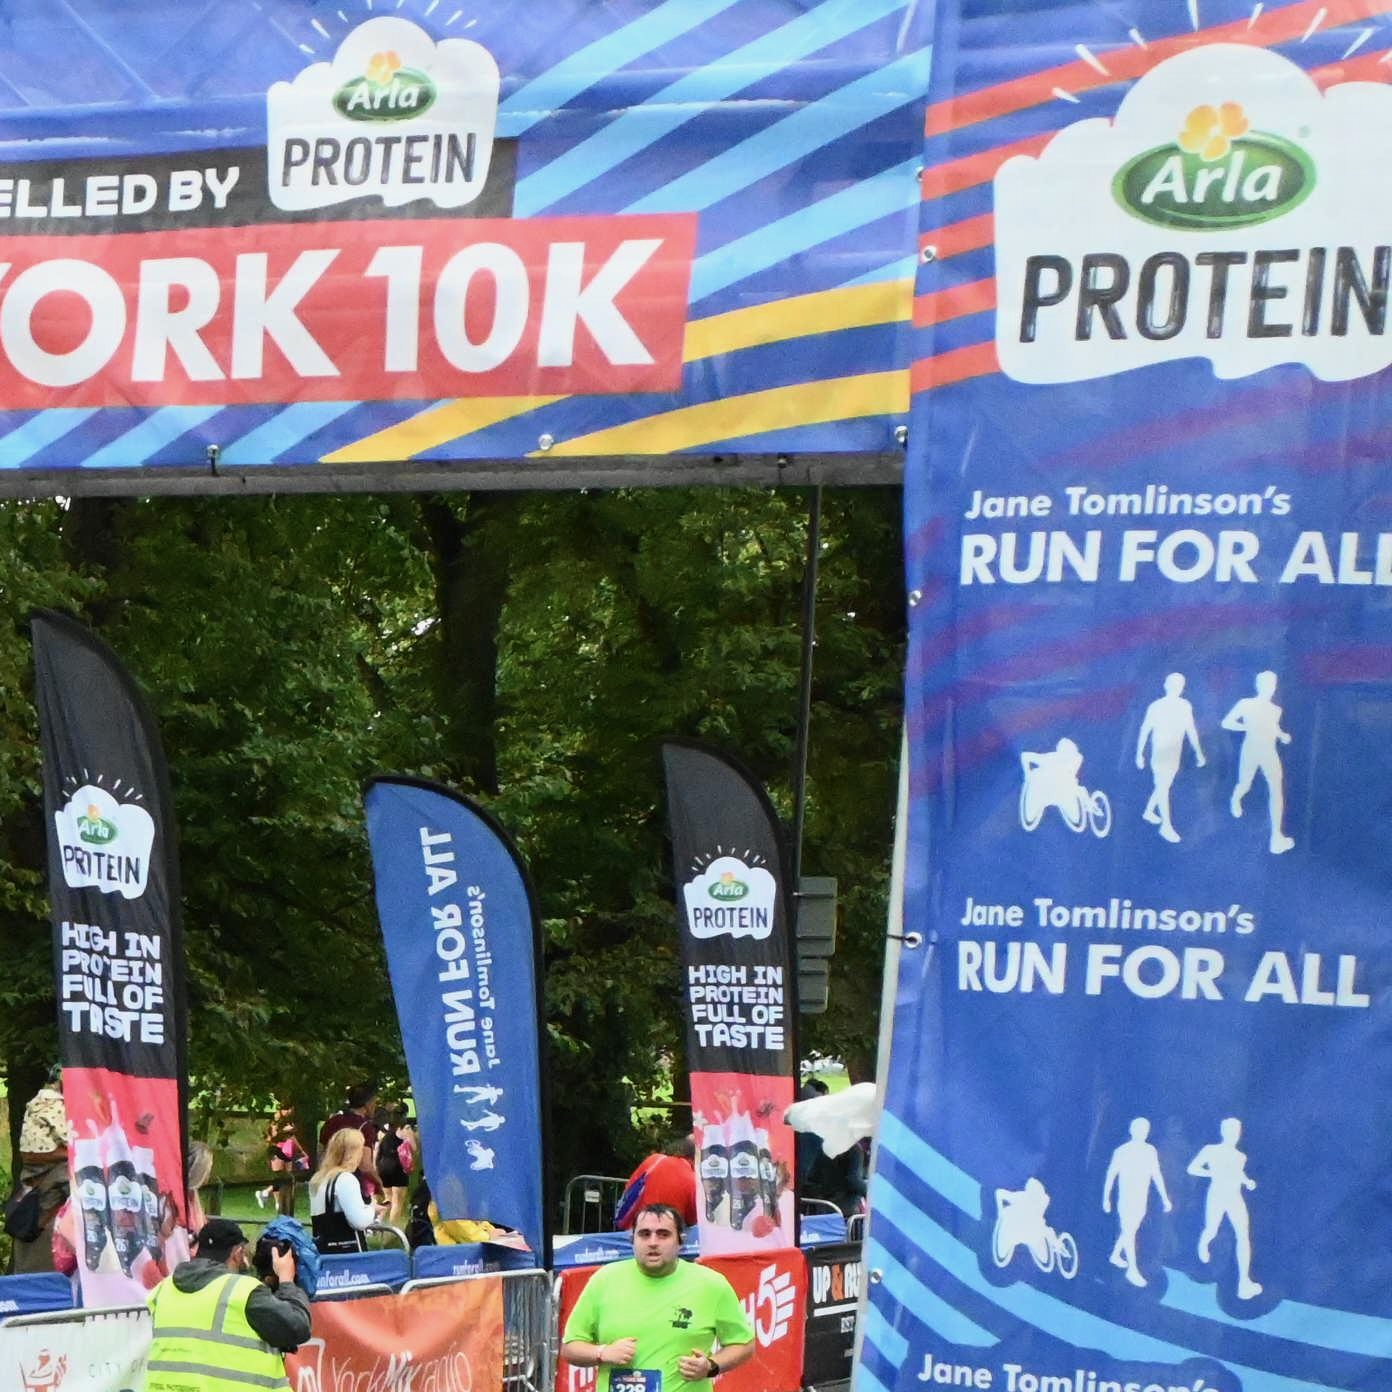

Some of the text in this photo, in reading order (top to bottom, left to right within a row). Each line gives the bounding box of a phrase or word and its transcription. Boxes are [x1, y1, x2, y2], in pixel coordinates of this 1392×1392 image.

[346, 78, 421, 111] Arla
[280, 132, 476, 188] PROTEIN
[1140, 152, 1283, 204] Arla
[168, 166, 241, 213] BY
[362, 239, 665, 374] 10K
[1018, 245, 1391, 343] PROTEIN
[964, 485, 1291, 518] Jane Tomlinson's
[959, 530, 1102, 586] RUN
[1119, 528, 1259, 583] FOR
[79, 820, 109, 837] Arla
[713, 884, 743, 897] Arla
[693, 906, 767, 929] PROTEIN
[961, 897, 1256, 934] Jane Tomlinson's
[62, 921, 160, 959] HIGH IN
[62, 949, 162, 985] PROEIN
[689, 965, 782, 985] HIGH IN
[957, 941, 1371, 1008] RUN FOR ALL
[62, 974, 163, 1010] FULL OF
[689, 985, 783, 1004] PROTEIN
[62, 1001, 164, 1044] TASTE
[692, 1004, 784, 1024] FULL OF
[694, 1024, 784, 1050] TASTE
[917, 1353, 993, 1389] Jane
